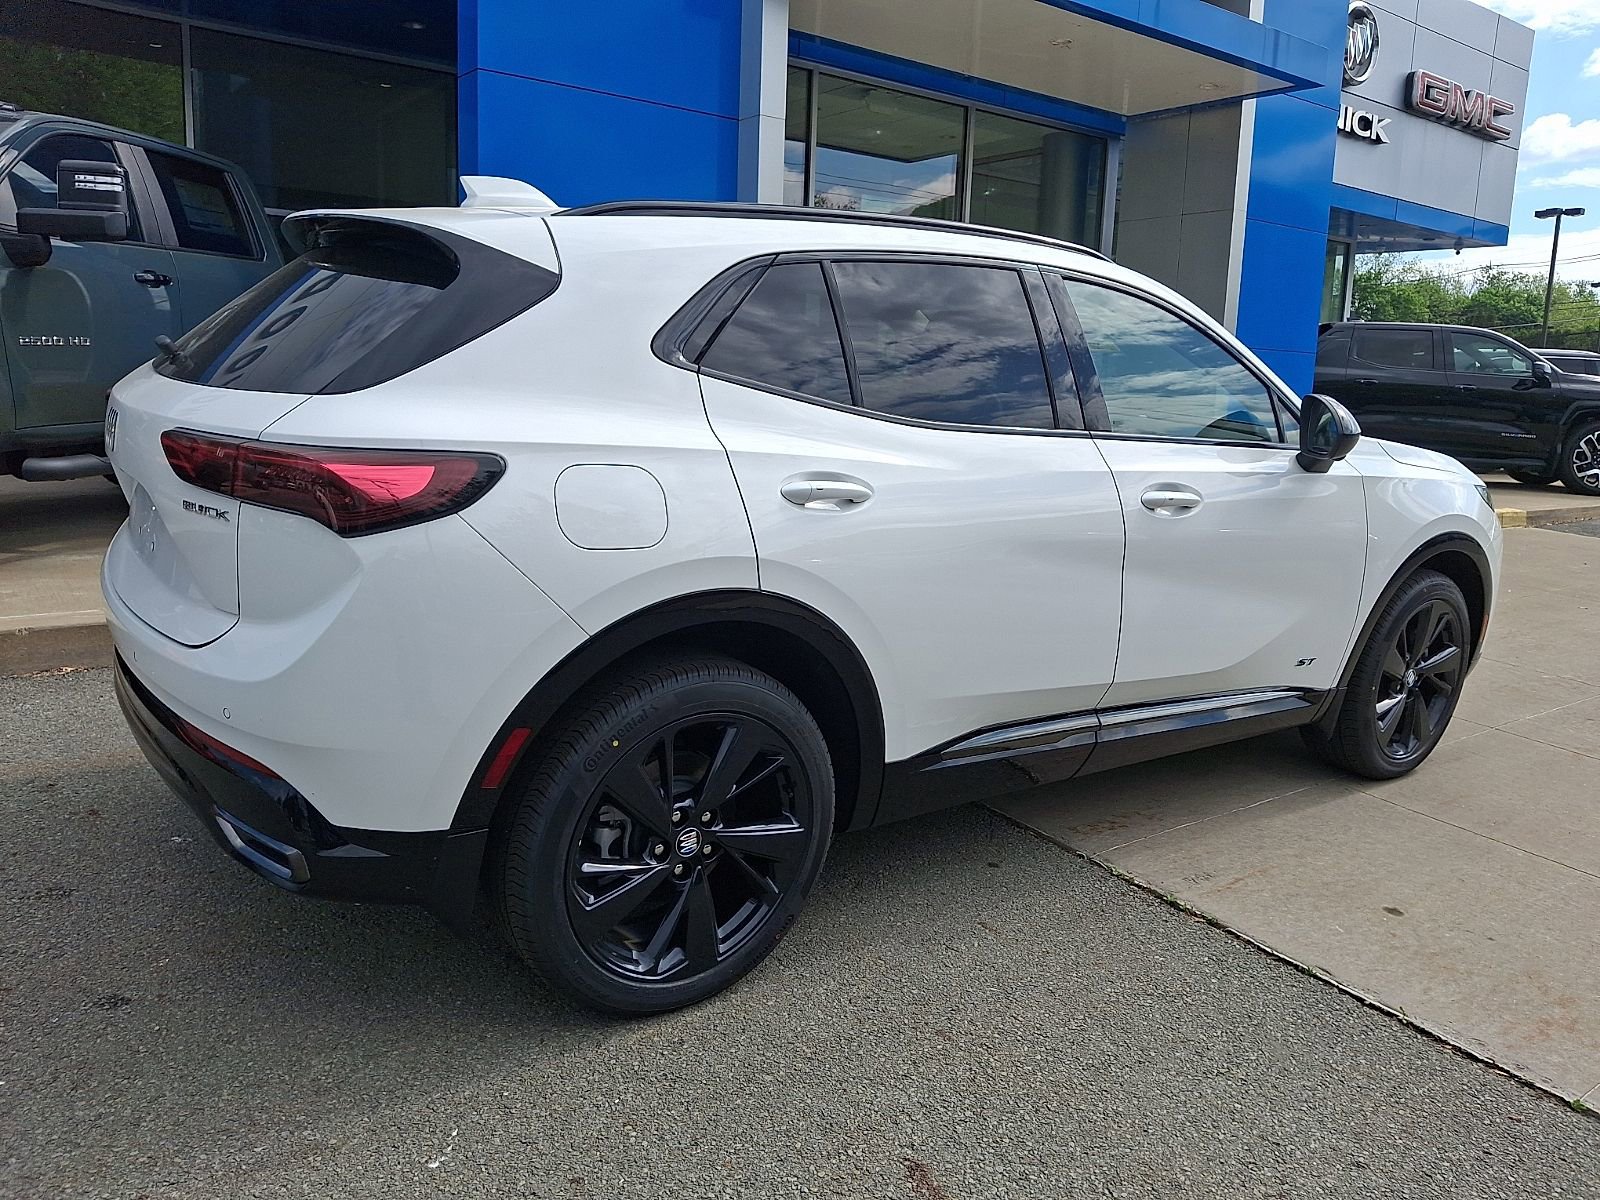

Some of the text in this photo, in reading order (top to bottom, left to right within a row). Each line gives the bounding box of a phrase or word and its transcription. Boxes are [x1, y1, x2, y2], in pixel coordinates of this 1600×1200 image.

[1413, 69, 1515, 140] GMC
[19, 336, 91, 345] 2500 HD
[182, 499, 230, 522] BUICK
[1294, 657, 1317, 667] ST
